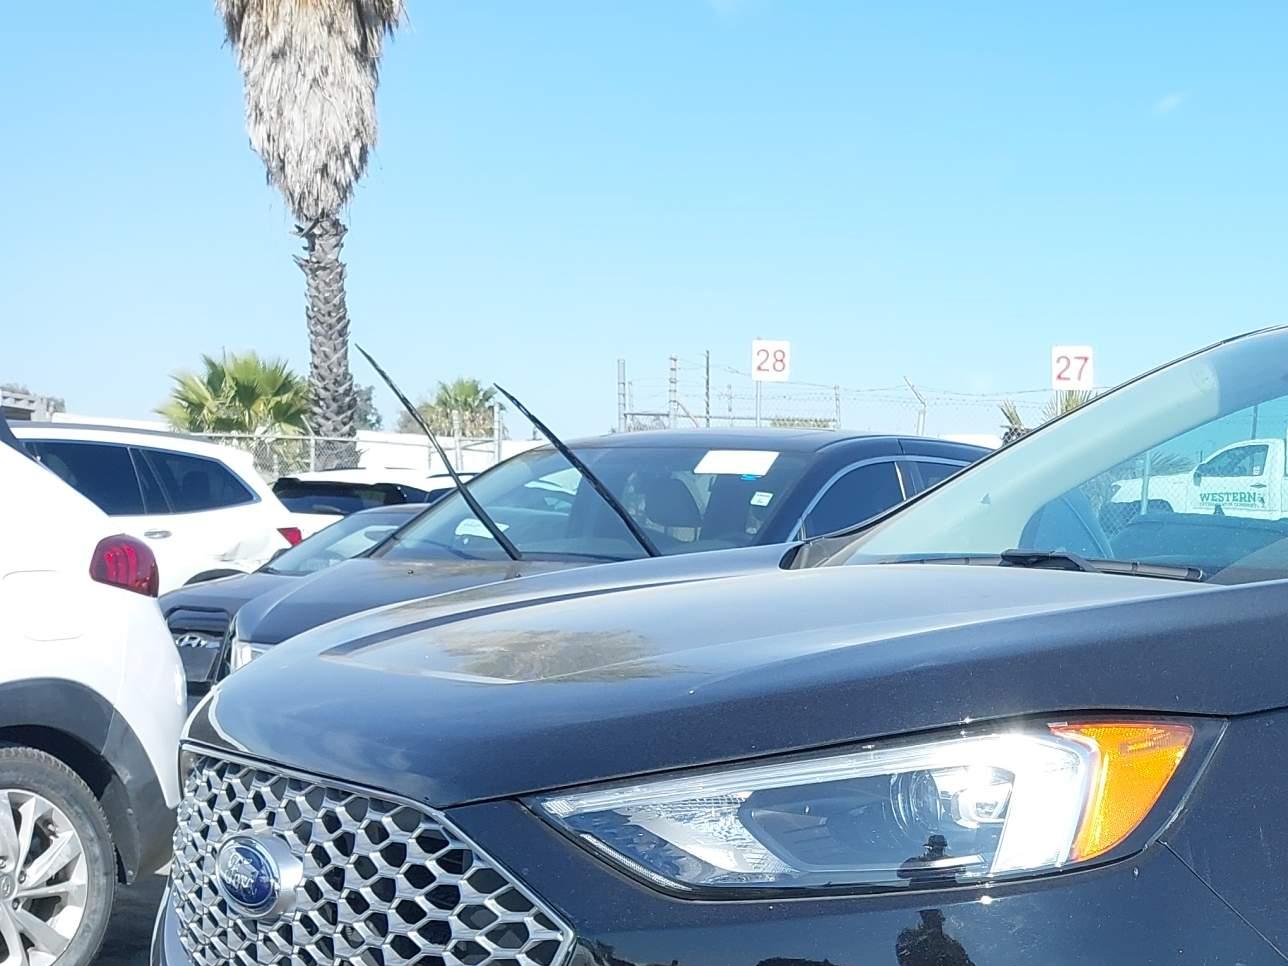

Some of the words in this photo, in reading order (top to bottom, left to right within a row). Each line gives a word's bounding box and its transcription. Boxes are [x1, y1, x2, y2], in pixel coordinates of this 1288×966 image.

[756, 348, 787, 373] 28
[1055, 355, 1089, 382] 27
[1199, 491, 1257, 504] WESTERN
